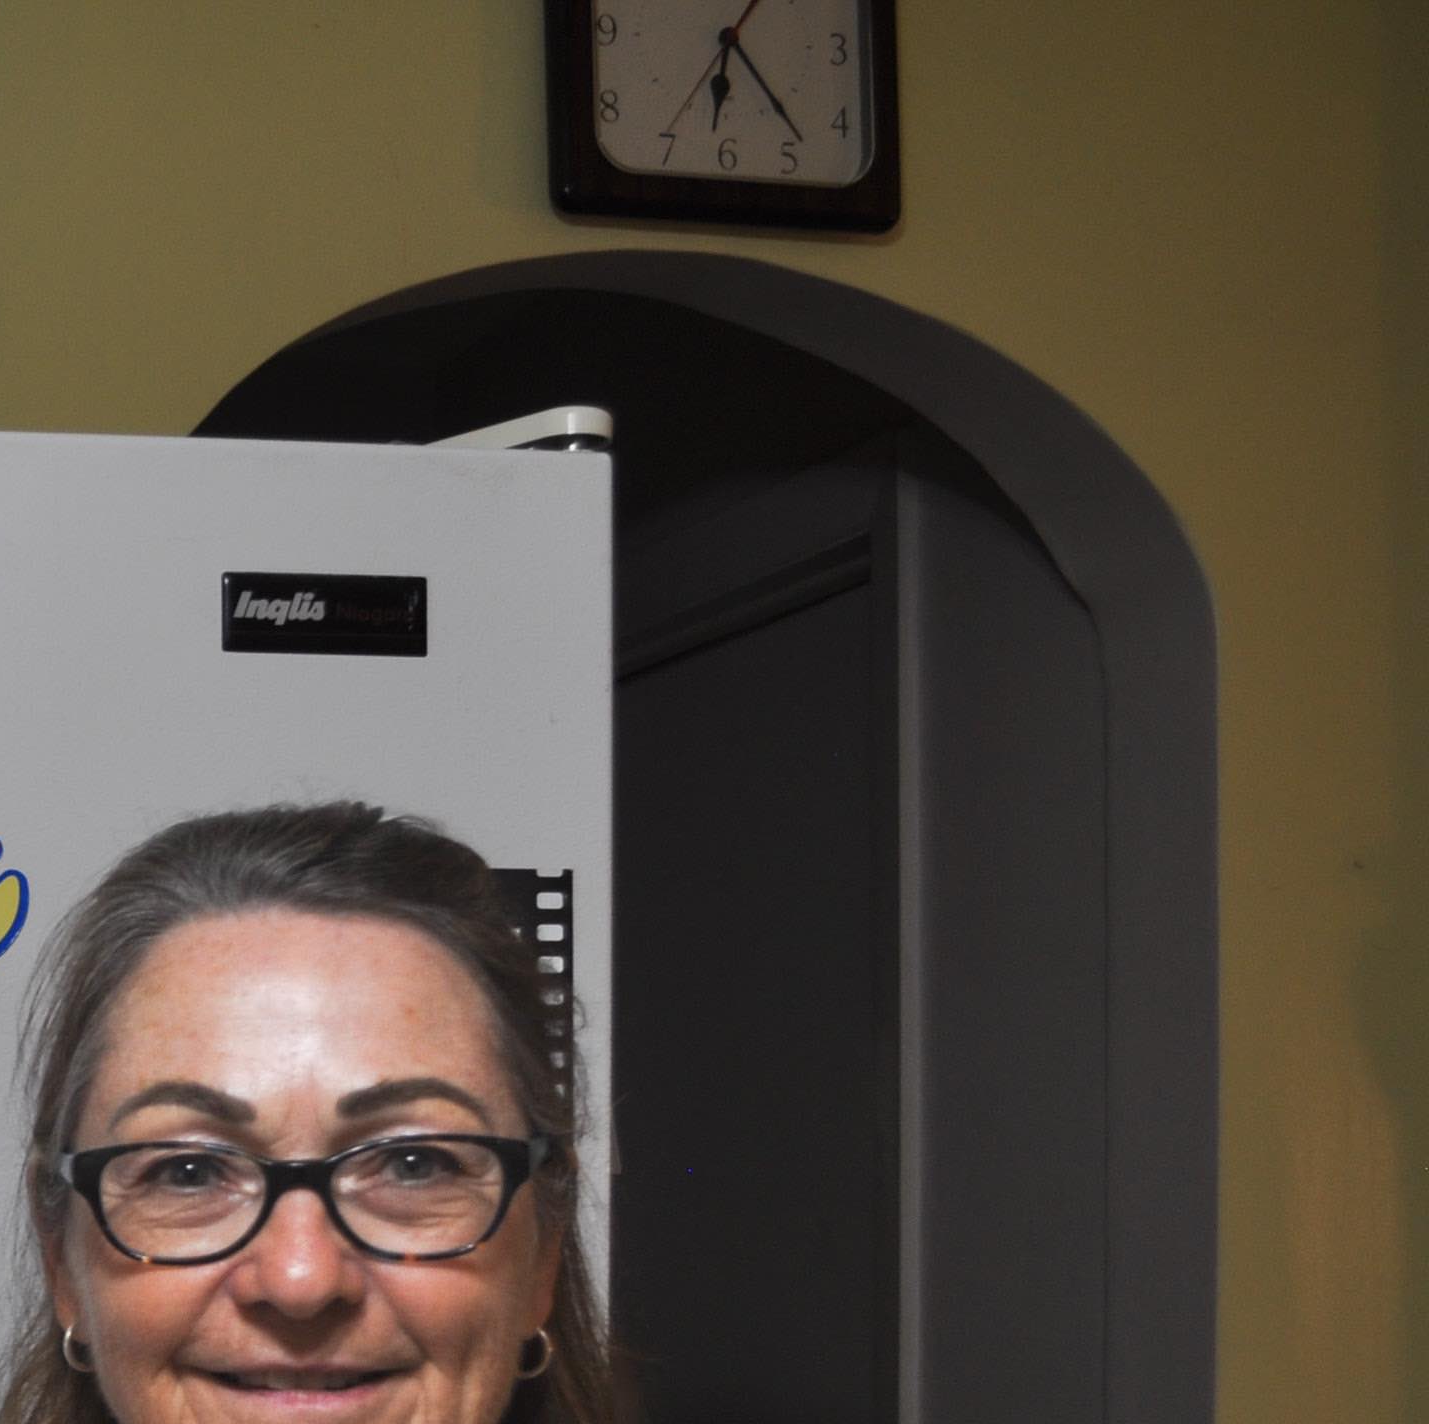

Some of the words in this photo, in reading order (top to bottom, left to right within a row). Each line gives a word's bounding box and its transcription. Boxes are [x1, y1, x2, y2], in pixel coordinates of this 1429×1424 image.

[596, 14, 617, 45] 9
[830, 33, 847, 65] 3
[600, 90, 619, 121] 8
[831, 107, 848, 138] 4
[659, 134, 675, 165] 7
[718, 138, 737, 169] 6
[781, 143, 798, 174] 5
[233, 590, 325, 626] Inglis
